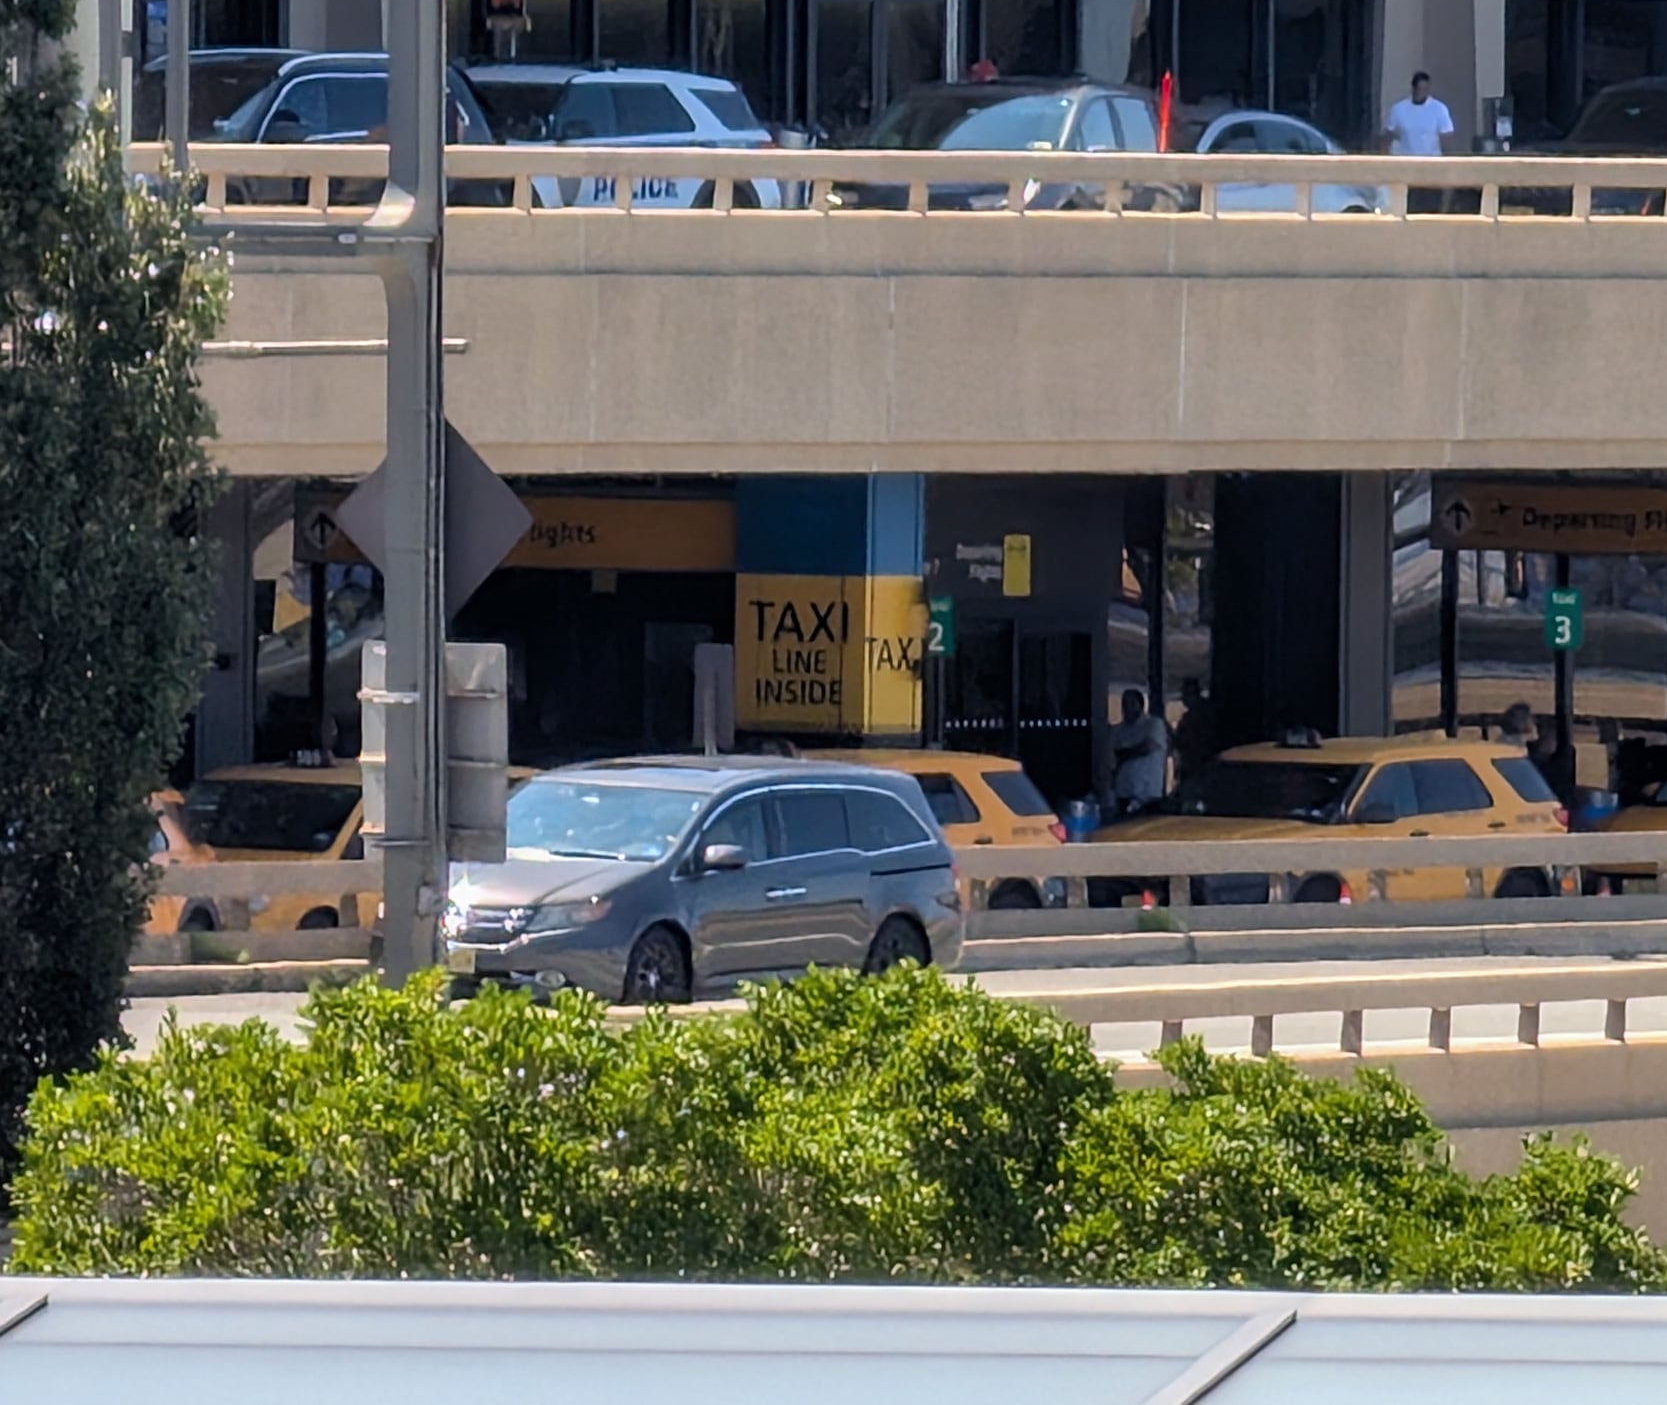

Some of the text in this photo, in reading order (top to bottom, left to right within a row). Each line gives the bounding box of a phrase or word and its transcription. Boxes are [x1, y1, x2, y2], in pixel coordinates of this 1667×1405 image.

[593, 176, 679, 201] PICE
[530, 521, 596, 547] lights
[749, 600, 849, 643] TAXI
[1554, 615, 1571, 644] 3
[927, 621, 946, 652] 2
[772, 649, 827, 675] LINE
[865, 637, 914, 671] TAX
[756, 679, 843, 706] INSIDE
